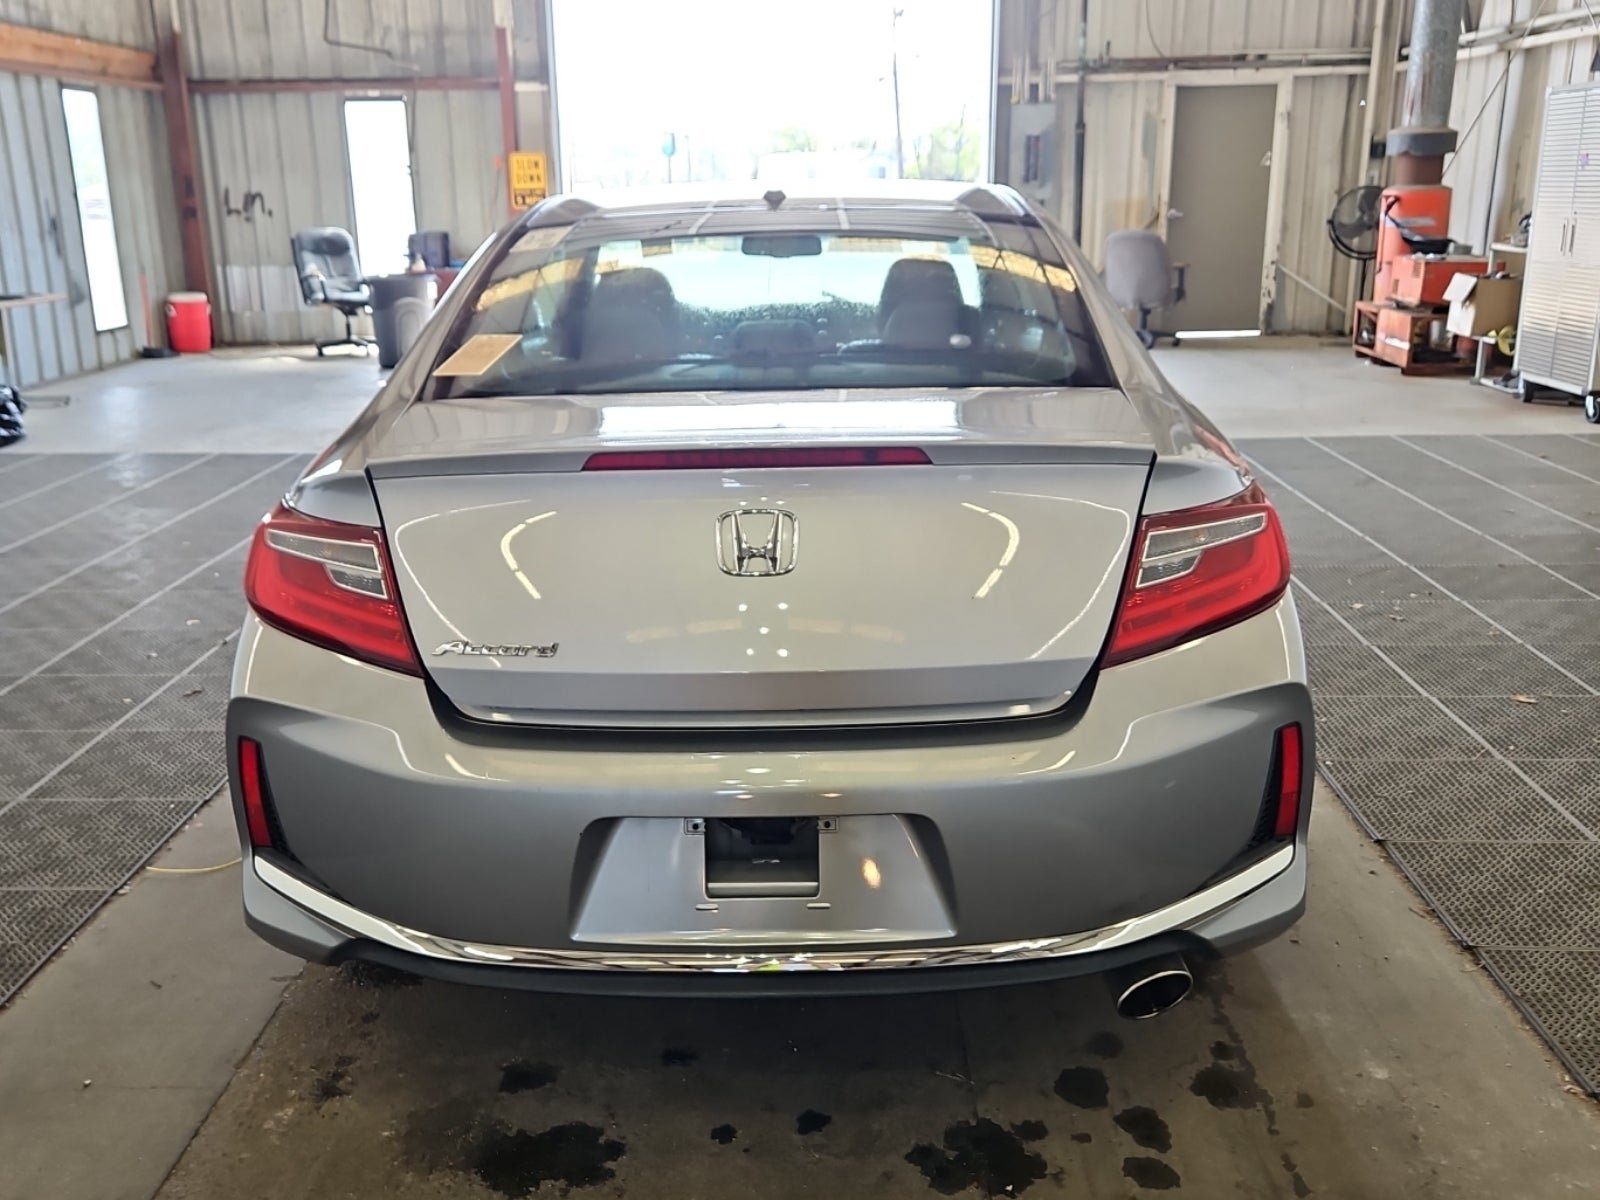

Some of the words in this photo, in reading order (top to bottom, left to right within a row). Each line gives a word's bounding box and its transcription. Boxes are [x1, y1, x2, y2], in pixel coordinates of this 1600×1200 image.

[515, 159, 541, 170] SLOW
[515, 174, 542, 185] DOWN
[431, 640, 560, 658] Accord
